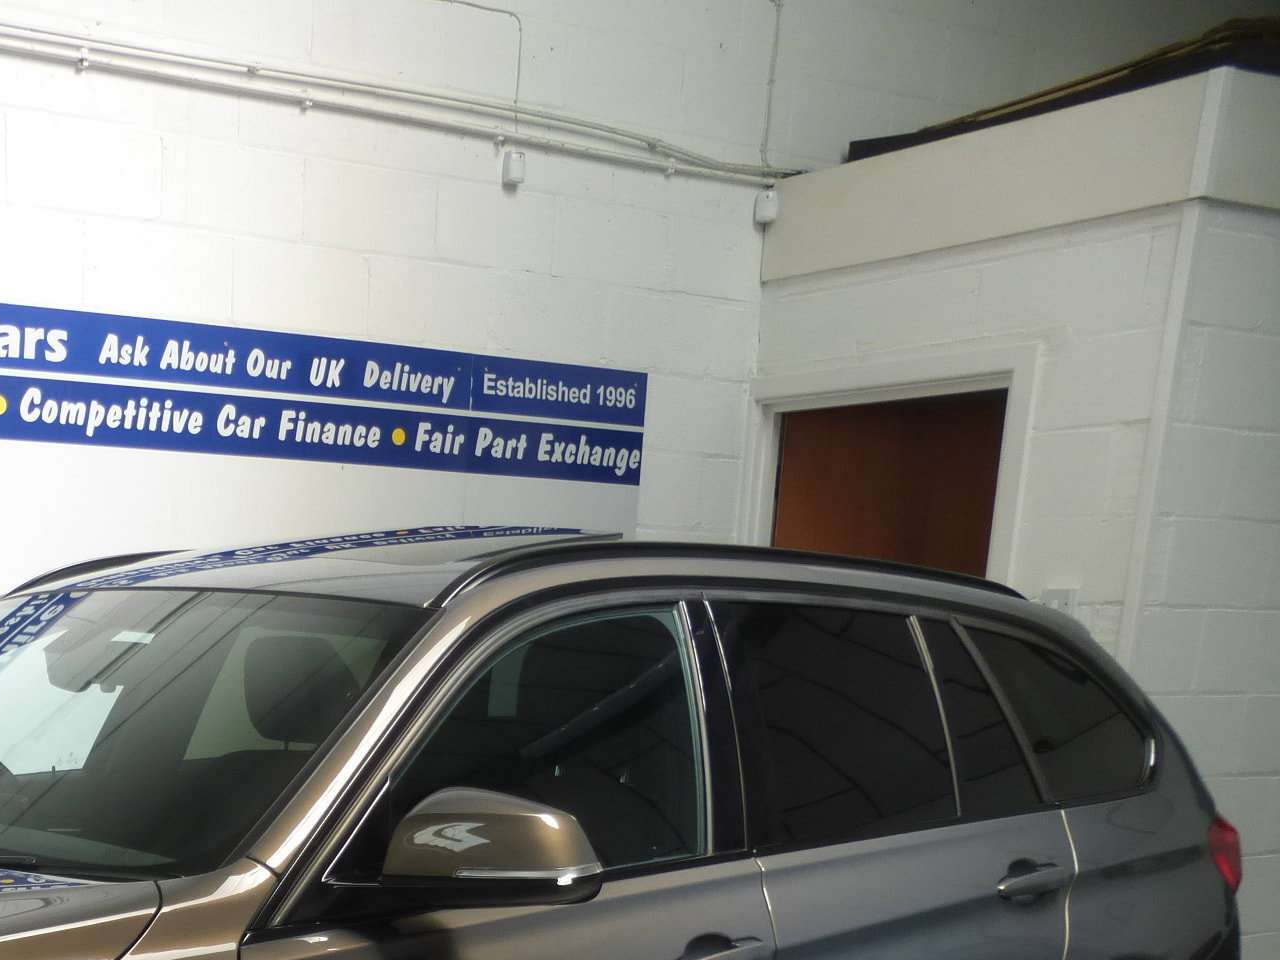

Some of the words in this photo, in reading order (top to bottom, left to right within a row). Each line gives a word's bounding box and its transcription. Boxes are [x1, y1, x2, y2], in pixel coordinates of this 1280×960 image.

[99, 333, 149, 367] Ask
[160, 340, 236, 376] About
[246, 348, 292, 381] Our
[309, 356, 345, 389] UK
[363, 361, 455, 404] Delivery
[483, 373, 591, 405] Established
[596, 386, 636, 409] 1996
[19, 387, 203, 437] Competitive
[216, 404, 265, 440] Car
[278, 410, 381, 449] Finance
[414, 422, 464, 456] Fair
[475, 427, 527, 461] Part
[537, 433, 641, 476] Exchange
